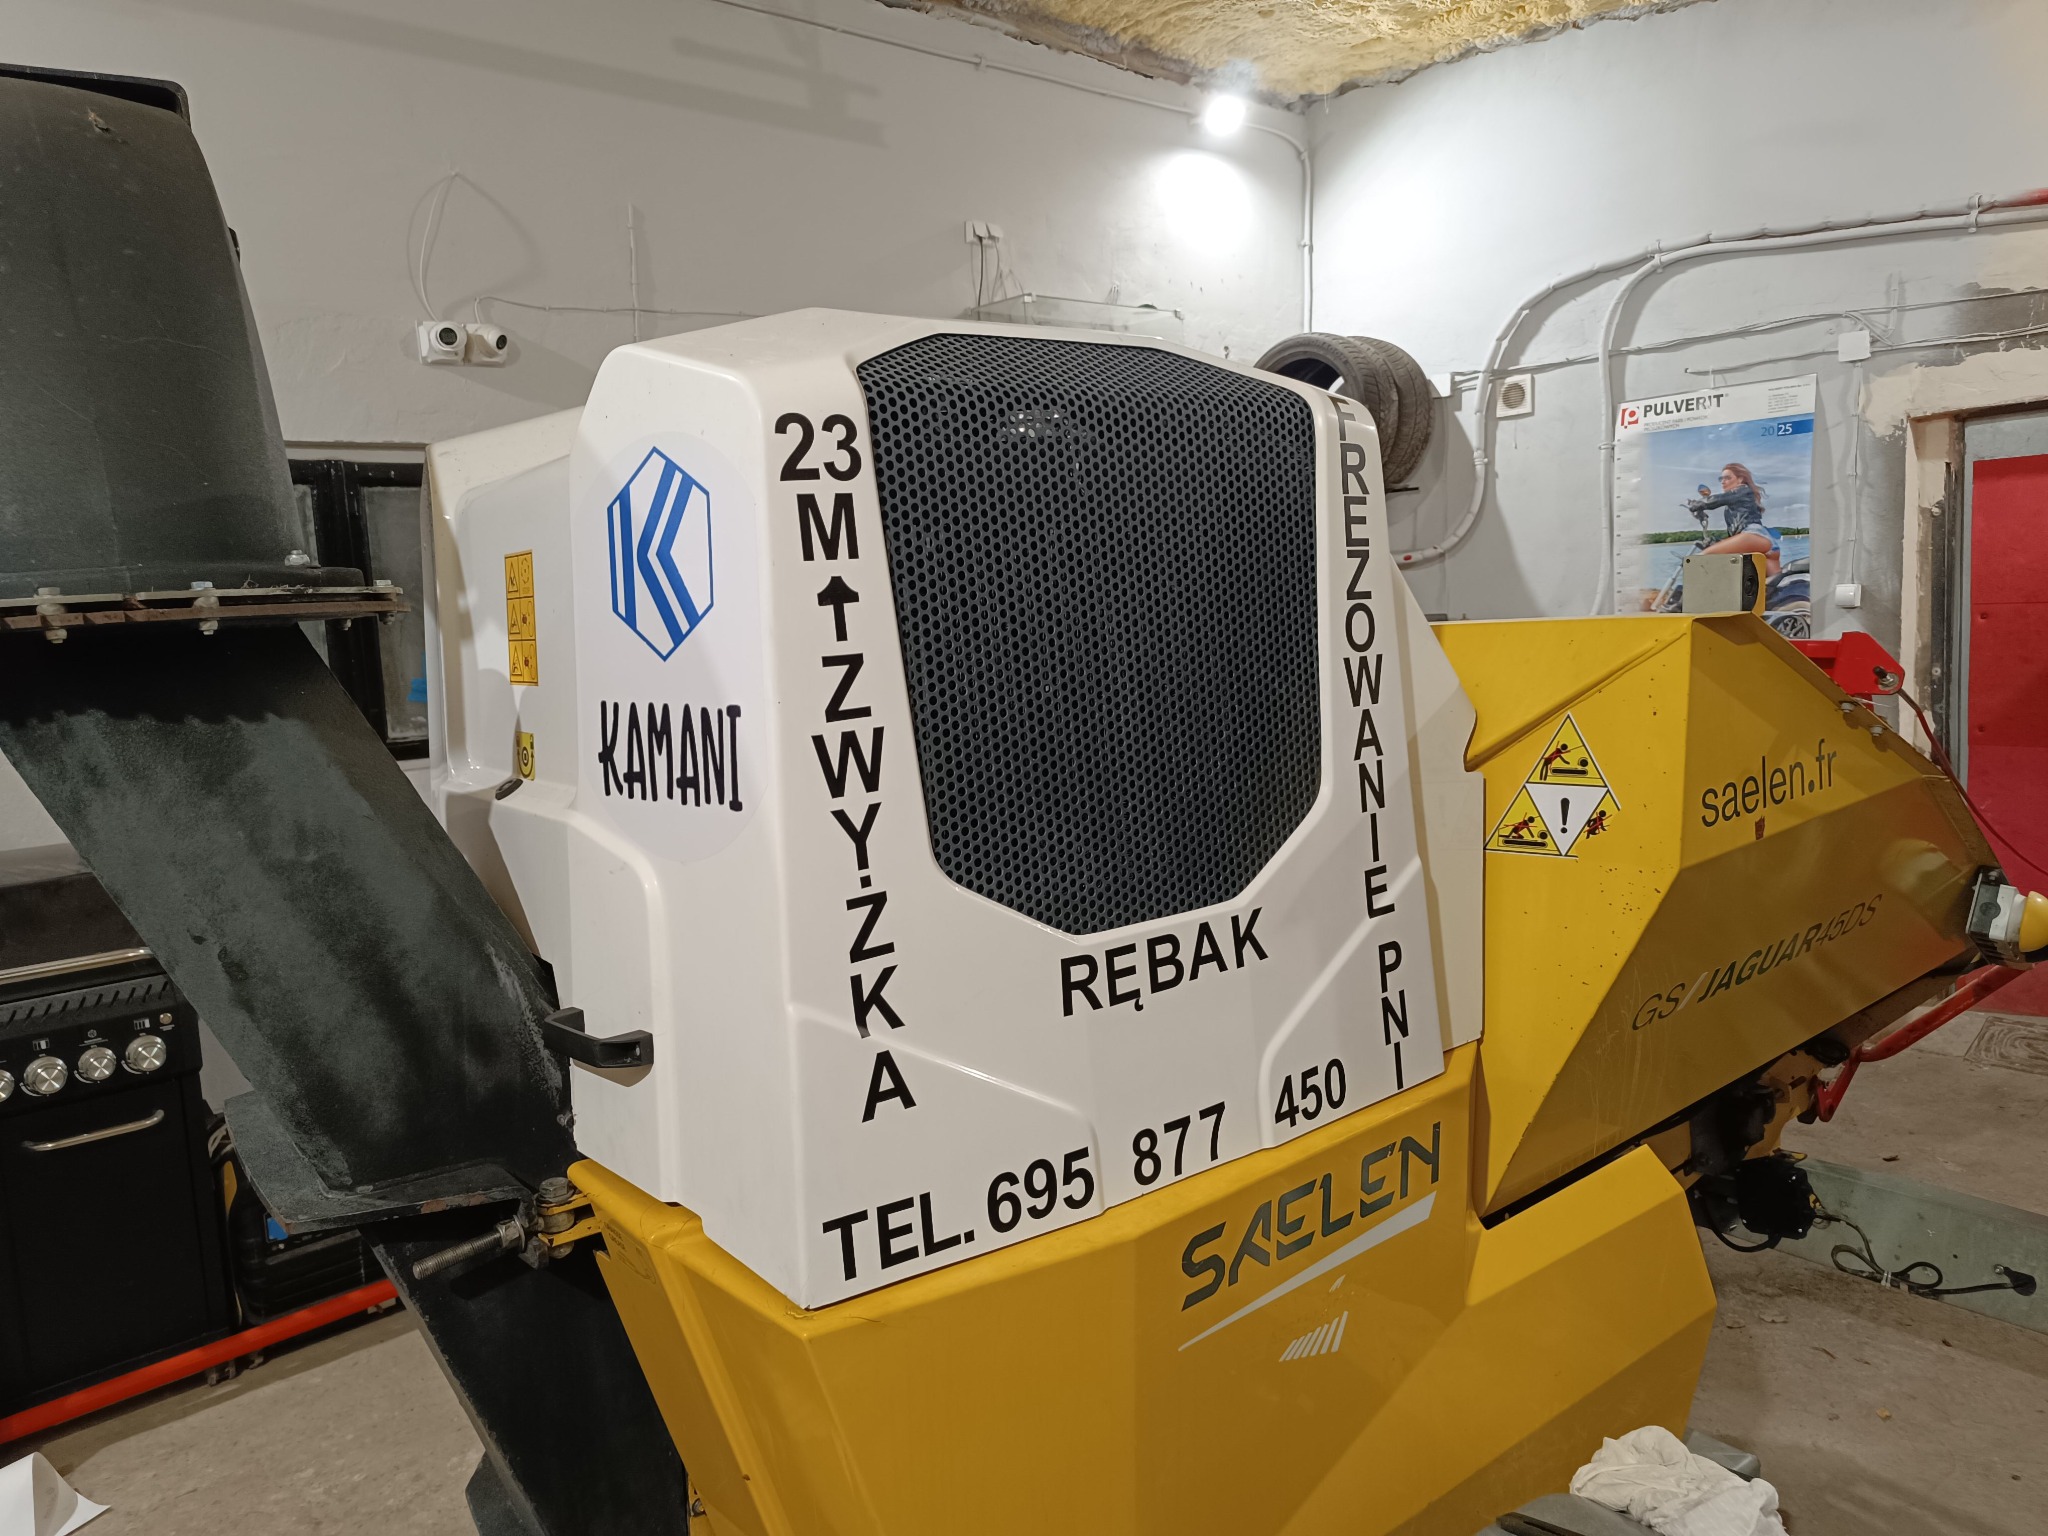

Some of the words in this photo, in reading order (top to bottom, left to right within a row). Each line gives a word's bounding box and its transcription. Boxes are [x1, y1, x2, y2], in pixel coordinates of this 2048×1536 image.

[774, 412, 863, 482] 23
[1643, 393, 1724, 418] PULVERIT
[796, 492, 860, 562] M
[598, 700, 743, 812] KAMANI
[1327, 396, 1396, 919] FREZOWANIE
[1378, 940, 1409, 1091] PNI
[1701, 738, 1837, 827] saelen.fr
[1060, 906, 1269, 1017] RĘBAK
[822, 1191, 975, 1282] TEL.
[987, 1146, 1095, 1234] 695
[1132, 1101, 1226, 1186] 877
[1274, 1058, 1346, 1128] 450
[1181, 1121, 1441, 1312] SAELEN
